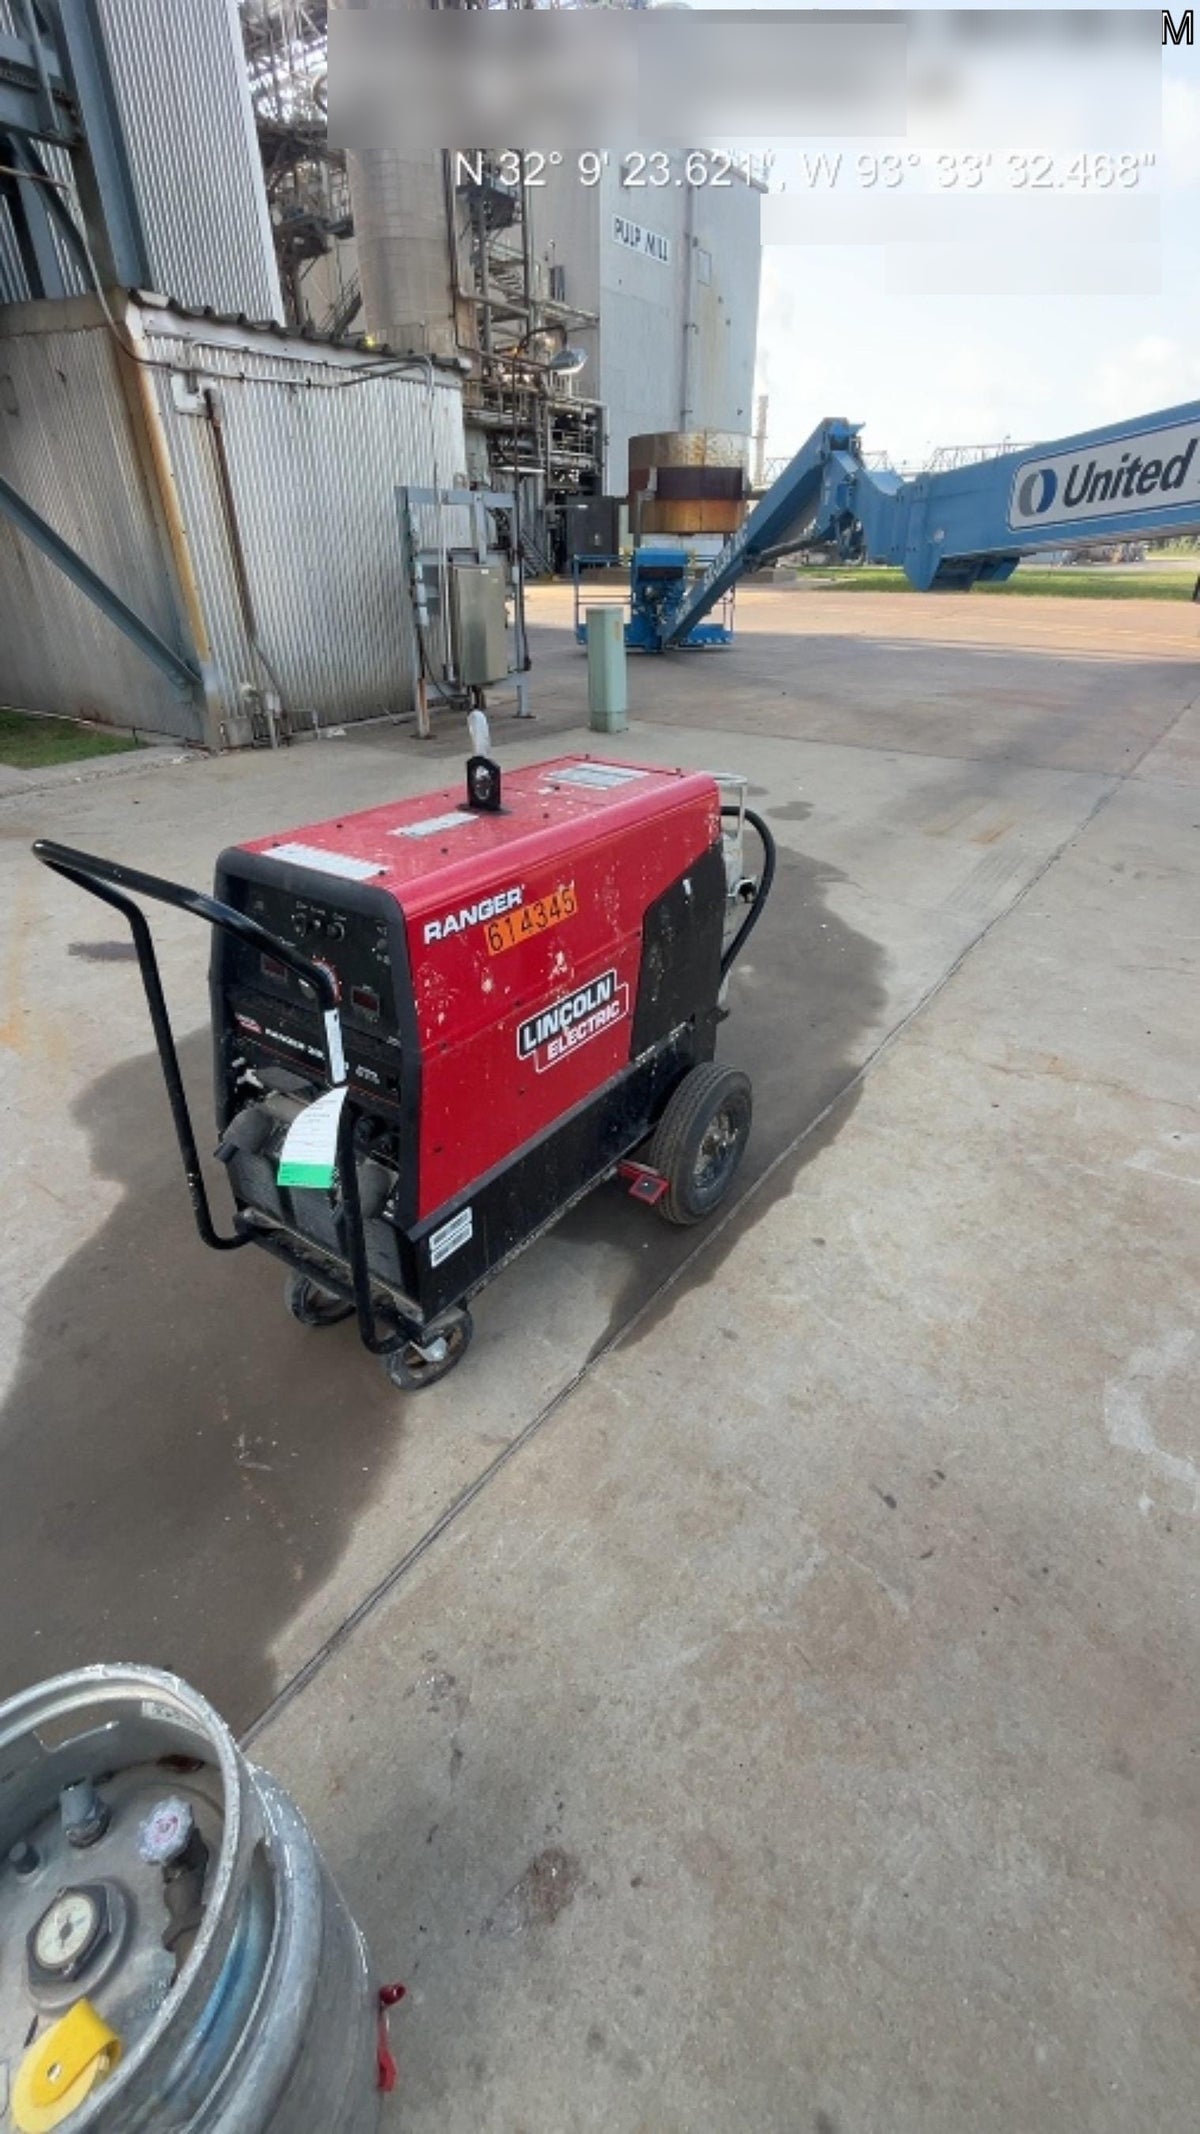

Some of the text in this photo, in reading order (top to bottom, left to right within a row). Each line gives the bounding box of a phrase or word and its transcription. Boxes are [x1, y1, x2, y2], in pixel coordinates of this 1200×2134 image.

[614, 217, 668, 261] PULP MILL
[1063, 437, 1199, 508] United
[423, 887, 524, 945] RANGER
[487, 887, 575, 952] 614345
[523, 976, 612, 1052] LINCOLN
[546, 999, 621, 1062] ELECTRIC
